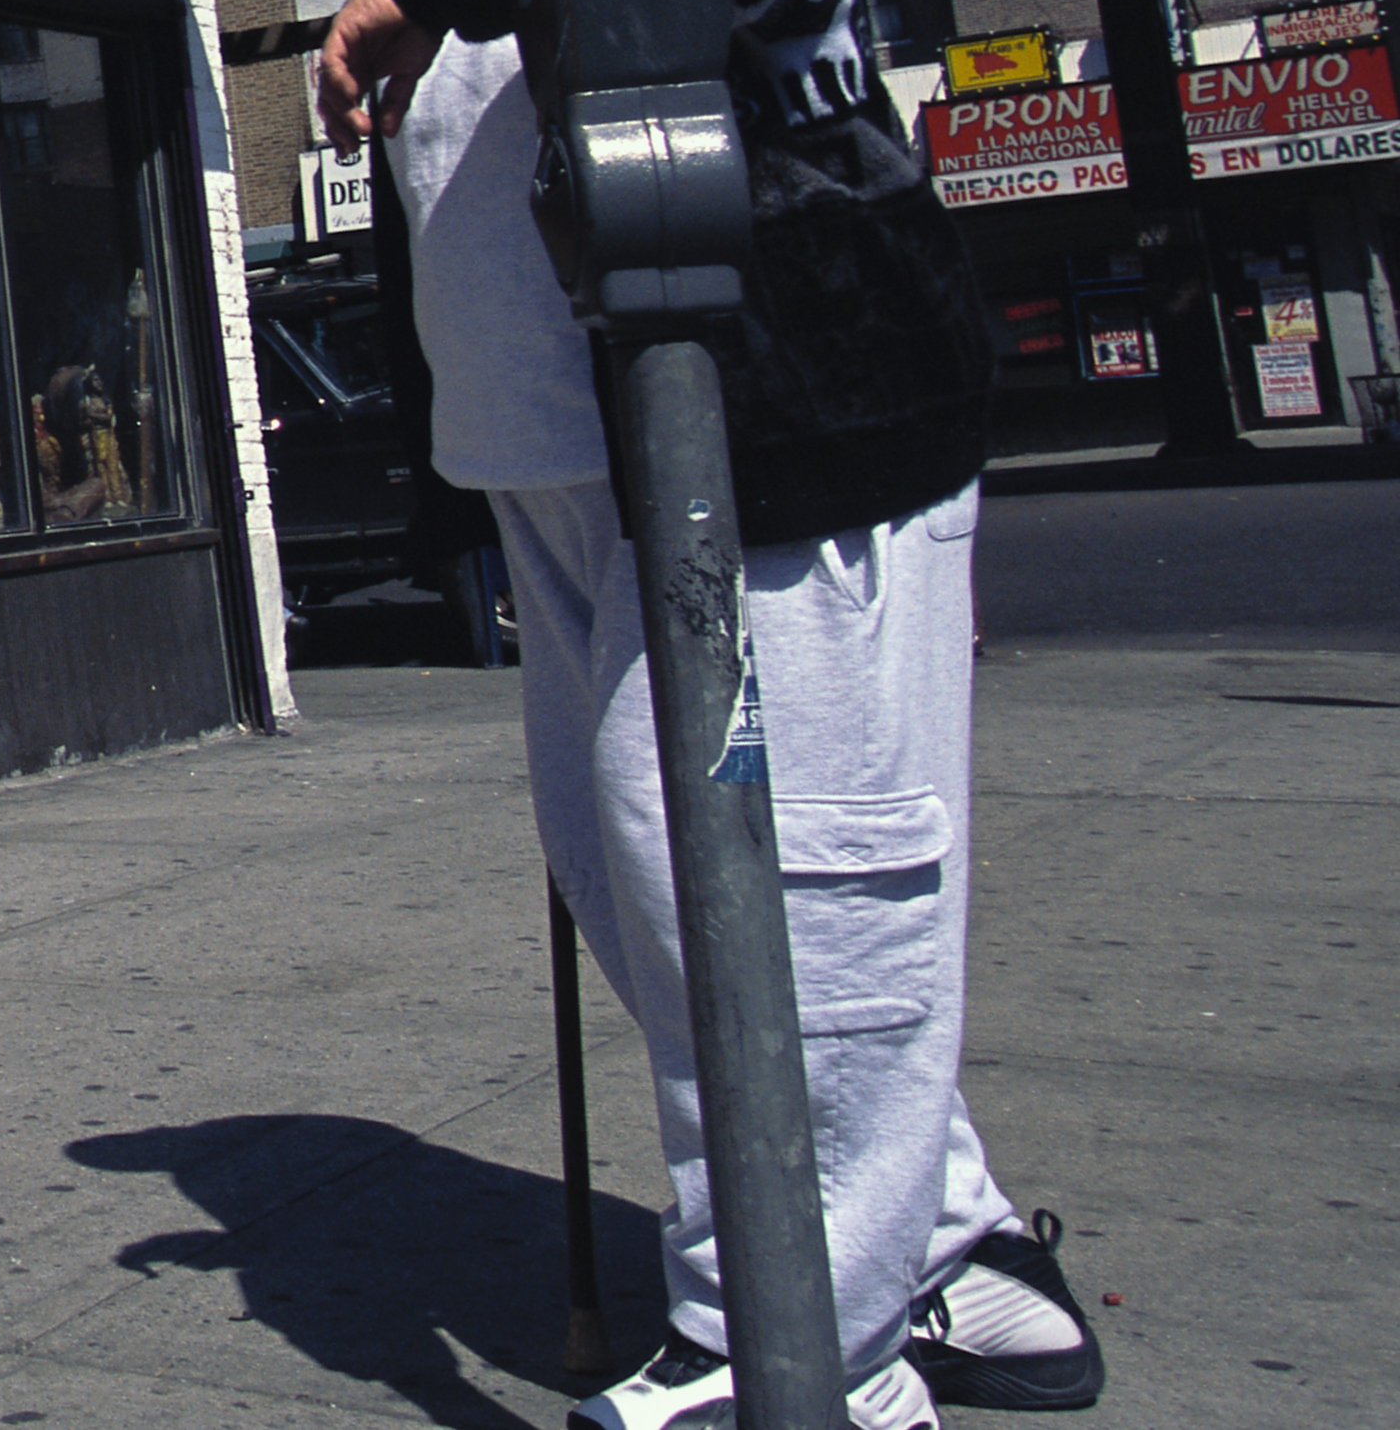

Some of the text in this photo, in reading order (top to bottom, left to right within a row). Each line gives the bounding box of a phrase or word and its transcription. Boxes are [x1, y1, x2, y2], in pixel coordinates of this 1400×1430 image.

[1284, 24, 1362, 46] PASAJES
[948, 52, 1350, 137] PRONT ENVIO
[1287, 87, 1370, 113] HELLO
[1282, 104, 1384, 130] TRAVEL
[976, 121, 1102, 152] LLAMADAS
[938, 136, 1122, 173] INTERNACIONAL
[943, 169, 1059, 205] MEXICO
[1221, 145, 1261, 172] EN
[1276, 129, 1400, 166] DOLARES
[329, 178, 371, 206] DEN
